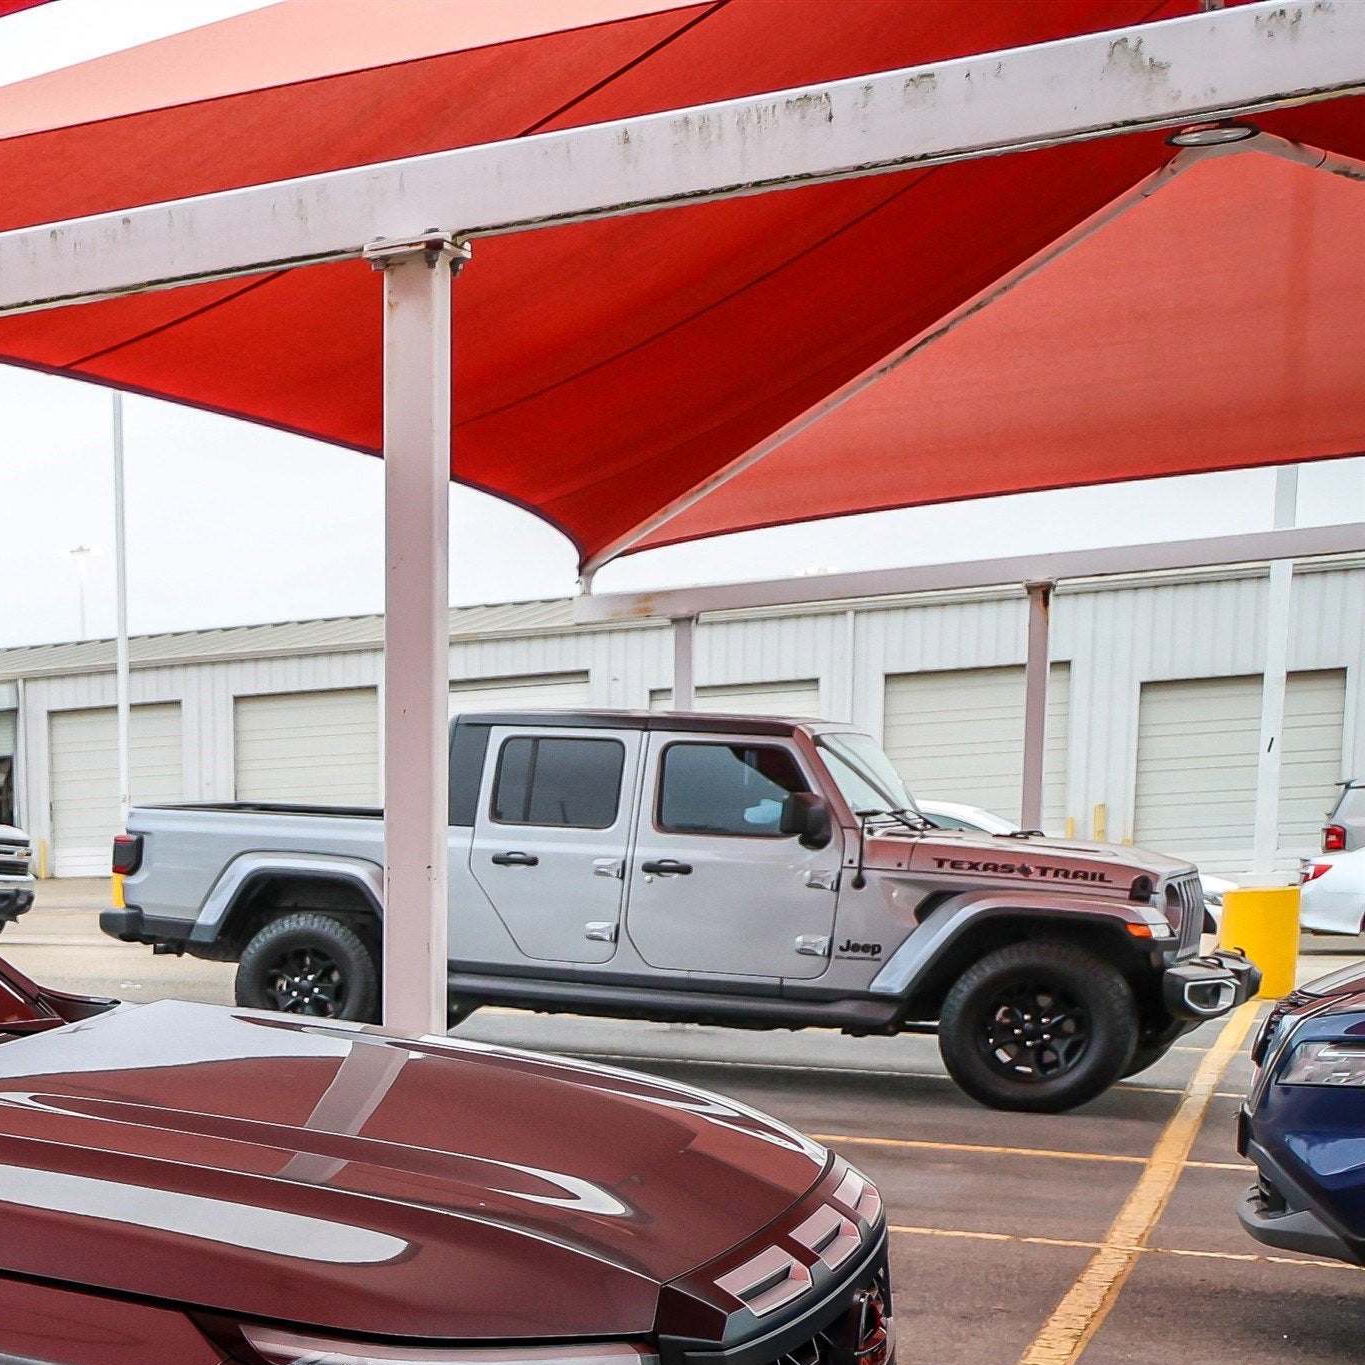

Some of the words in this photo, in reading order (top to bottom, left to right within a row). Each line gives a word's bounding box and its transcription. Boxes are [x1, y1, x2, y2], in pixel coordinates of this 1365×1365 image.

[931, 857, 1017, 874] TEXAS
[1034, 864, 1114, 884] TRAIL
[838, 938, 883, 957] Jeep
